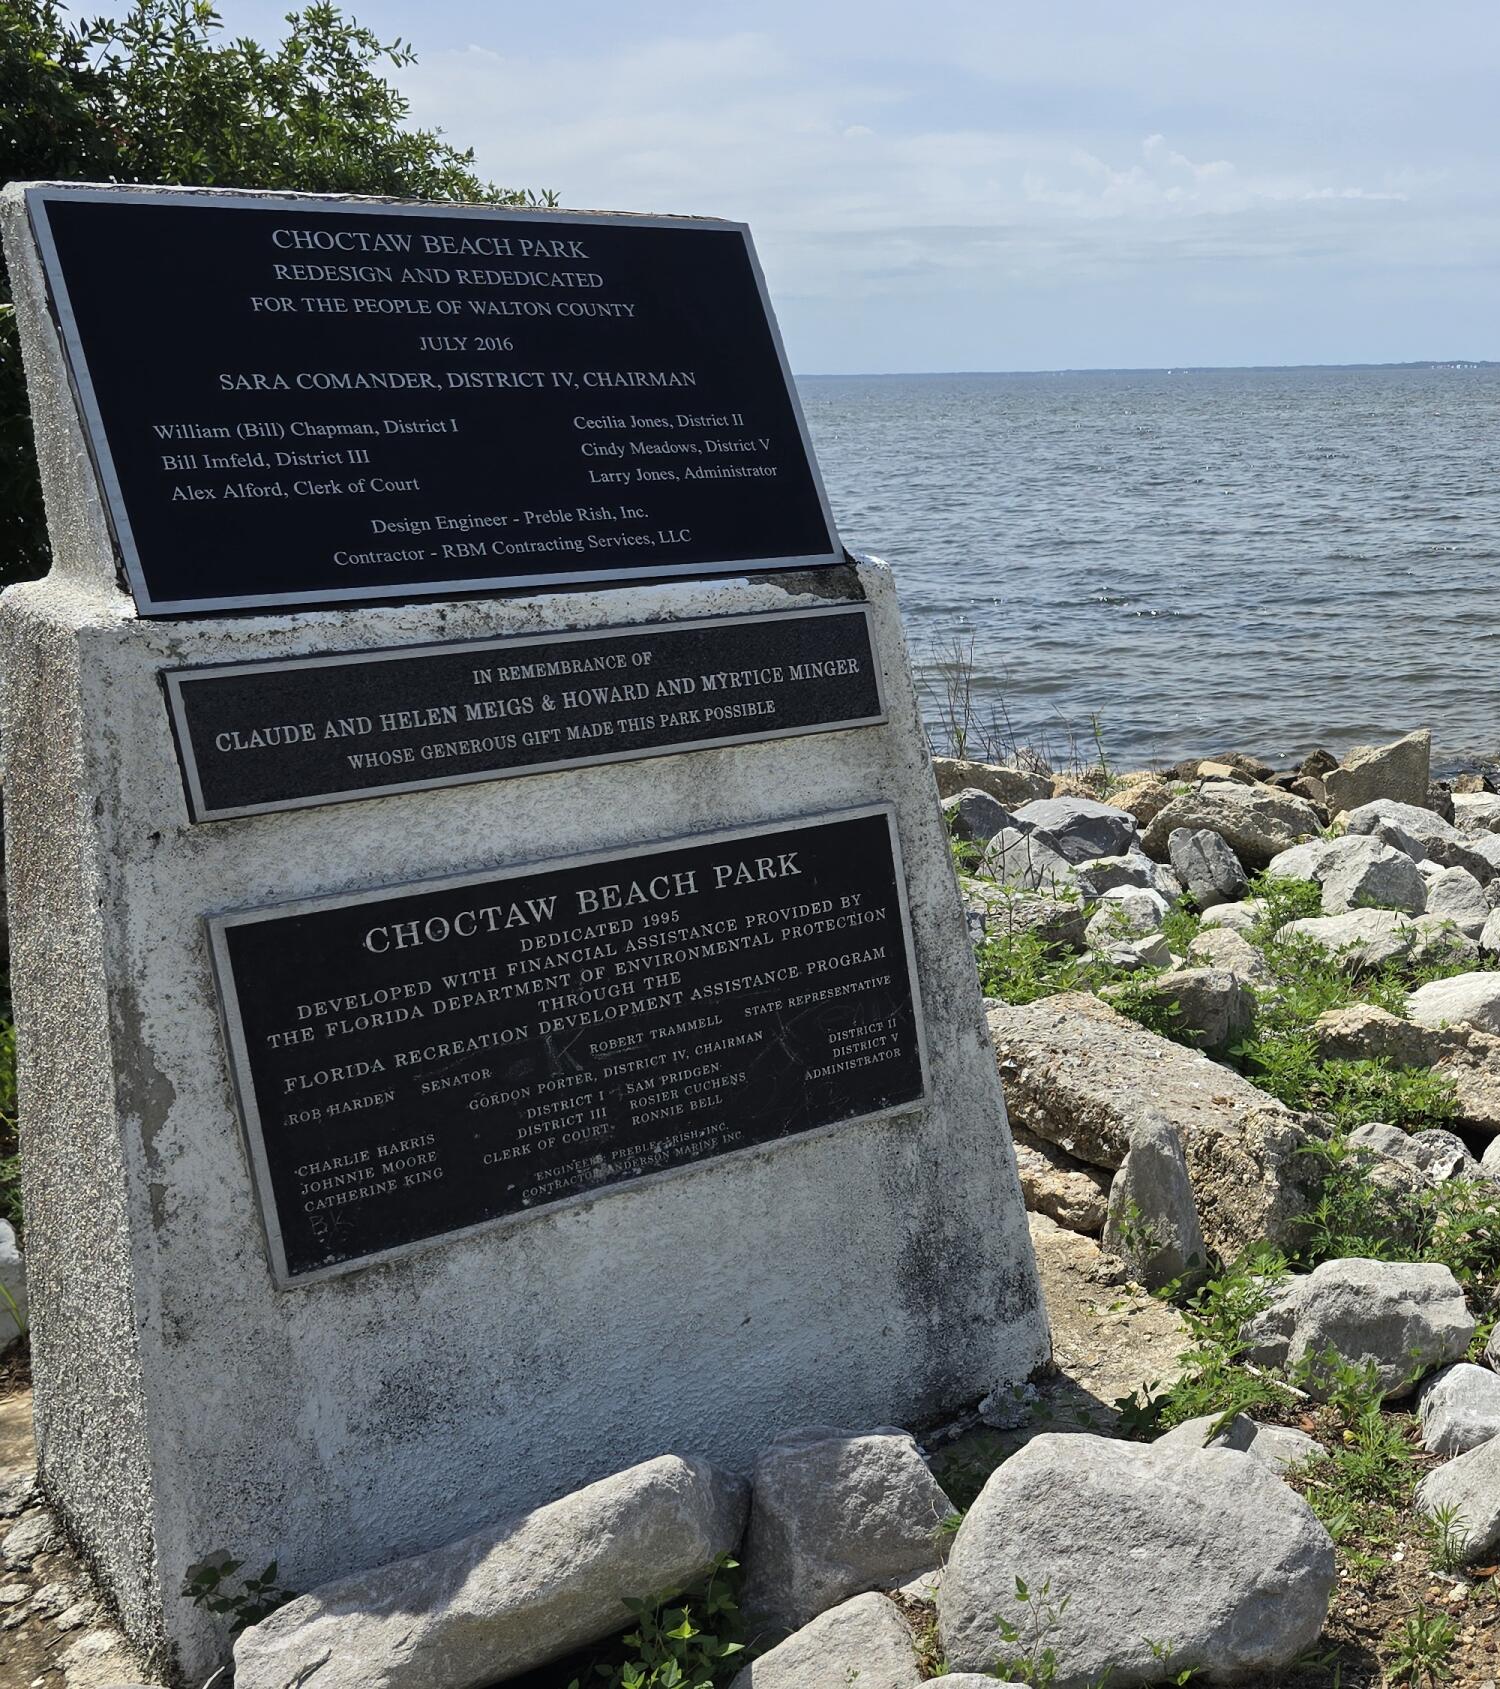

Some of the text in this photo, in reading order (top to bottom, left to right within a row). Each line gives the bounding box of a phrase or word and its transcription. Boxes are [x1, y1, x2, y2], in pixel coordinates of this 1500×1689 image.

[271, 228, 590, 259] CHOCTAW BEACH PARK
[272, 263, 604, 288] REDESIGN AND REDEDICATED
[249, 296, 635, 317] FOR THE PEOPLE OF WALTON COUNTY
[419, 336, 514, 351] JULY 2016
[218, 371, 697, 391] SARA COMANDER, DISTRICT IV, CHAIRMAN
[151, 418, 459, 440] William (Bill) Chapman, District I
[572, 412, 745, 430] Cecilia Jones, District II
[160, 448, 370, 471] Bill Imfeld, District III
[580, 437, 770, 459] Cindy Meadows, District V
[171, 477, 420, 501] Alex Alford, Clerk of Court
[587, 464, 777, 486] Larry Jones, Administrator
[370, 517, 432, 535] Design
[434, 513, 508, 532] Engineer
[522, 508, 574, 525] Preble
[575, 506, 617, 522] Rish,
[619, 505, 649, 519] Inc.
[333, 549, 425, 566] Contractor
[441, 541, 487, 559] RBM
[491, 536, 585, 555] Contracting
[586, 532, 656, 548] Services,
[657, 528, 692, 544] LLC
[471, 650, 653, 685] IN REMEMBRANCE OF
[214, 657, 860, 752] CLAUDE AND HELEN MEIGS & HOWARD AND MYRTICE MINGER
[346, 699, 776, 769] WHOSE GENEROUS GIFT MADE THIS PARK POSSIBLE
[362, 851, 802, 953] CHOCTAW BEACH PARK
[519, 909, 680, 953] DEDICATED 1995
[296, 893, 862, 1020] DEVELOPED WITH FINANCIAL ASSISTANCE PROVIDED BY
[266, 906, 886, 1049] THE FLORIDA DEPARTMENT OF ENVIRONMENTAL PROTECTION
[537, 970, 681, 1013] THROUGH THE
[743, 999, 783, 1018] STATE
[787, 974, 891, 1008] REPRESENTATIVE
[283, 945, 886, 1095] FLORIDA RECREATION DEVELOPMENT ASSISTANCE PROGRAM
[588, 1014, 723, 1057] ROBERT TRAMMELL
[828, 1017, 897, 1044] DISTRICT II
[832, 1032, 899, 1058] DISTRICT V
[420, 1067, 493, 1094] SENATOR
[468, 1029, 763, 1111] GORDON PORTER, DISTRICT IV, CHAIRMAN
[624, 1061, 719, 1094] SAM PRIDGEN
[804, 1047, 901, 1081] ADMINISTRATOR
[526, 1090, 604, 1119] DISTRICT I
[629, 1071, 746, 1110] ROSIER CUCHENS
[287, 1090, 395, 1125] ROB HARDEN
[517, 1106, 607, 1139] DISTRICT III
[631, 1093, 723, 1126] RONNIE BELL
[482, 1122, 609, 1165] CLERK OF COURT
[706, 1121, 728, 1134] INC.
[297, 1133, 435, 1177] CHARLIE HARRIS
[674, 1136, 718, 1156] MARINE
[300, 1150, 437, 1195] JOHNNIE MOORE
[303, 1166, 443, 1213] CATHERINE KING
